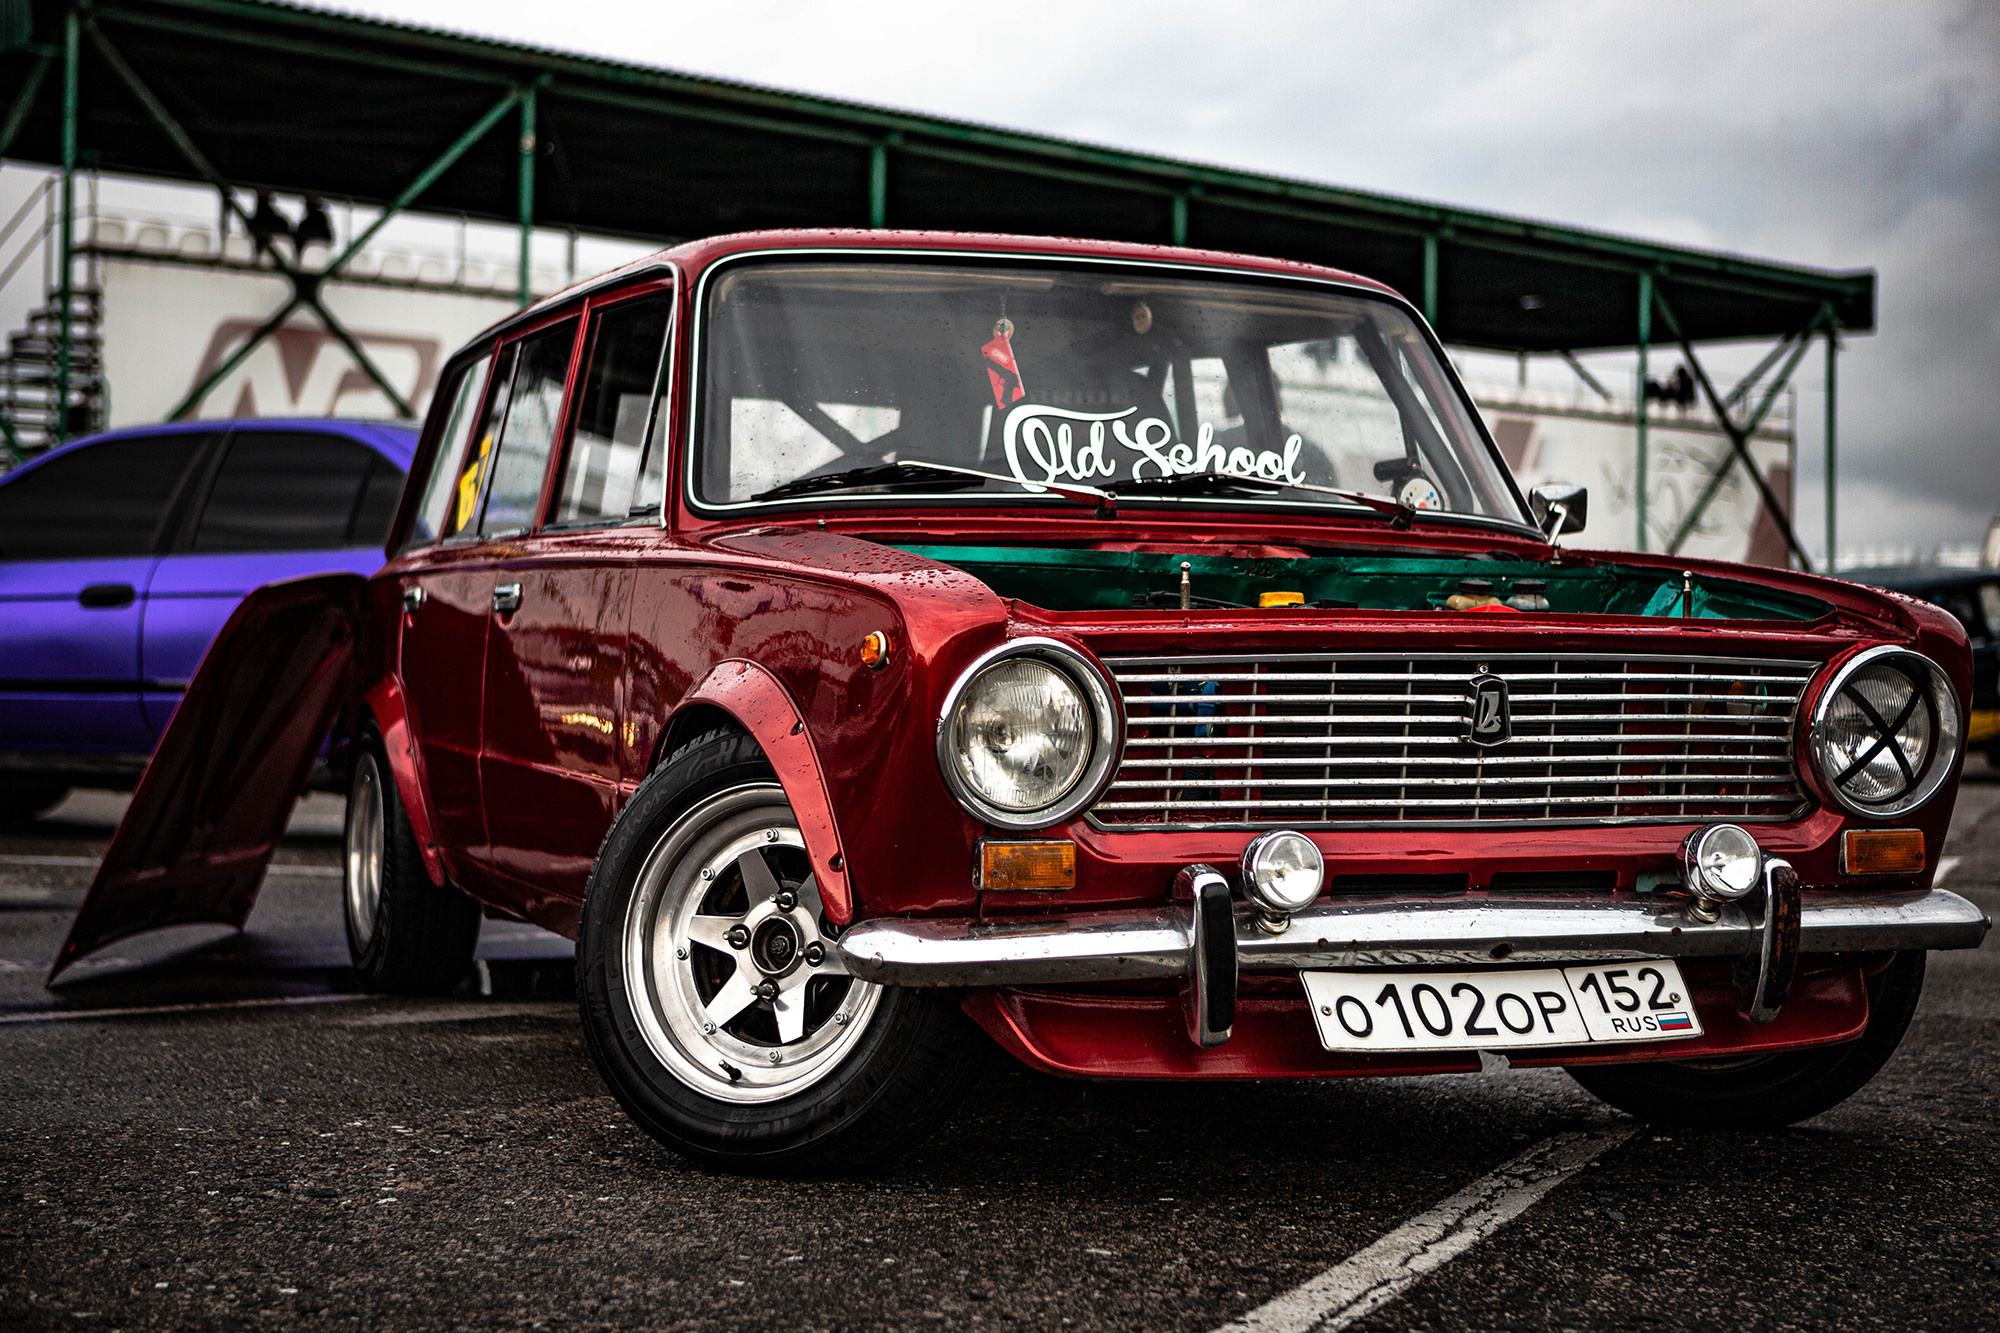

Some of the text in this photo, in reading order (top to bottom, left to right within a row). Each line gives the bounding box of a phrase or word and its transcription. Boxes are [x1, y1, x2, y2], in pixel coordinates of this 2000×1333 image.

[1003, 404, 1307, 493] Old School
[1334, 966, 1675, 1039] O102OP 152
[1611, 1015, 1658, 1034] RUS
